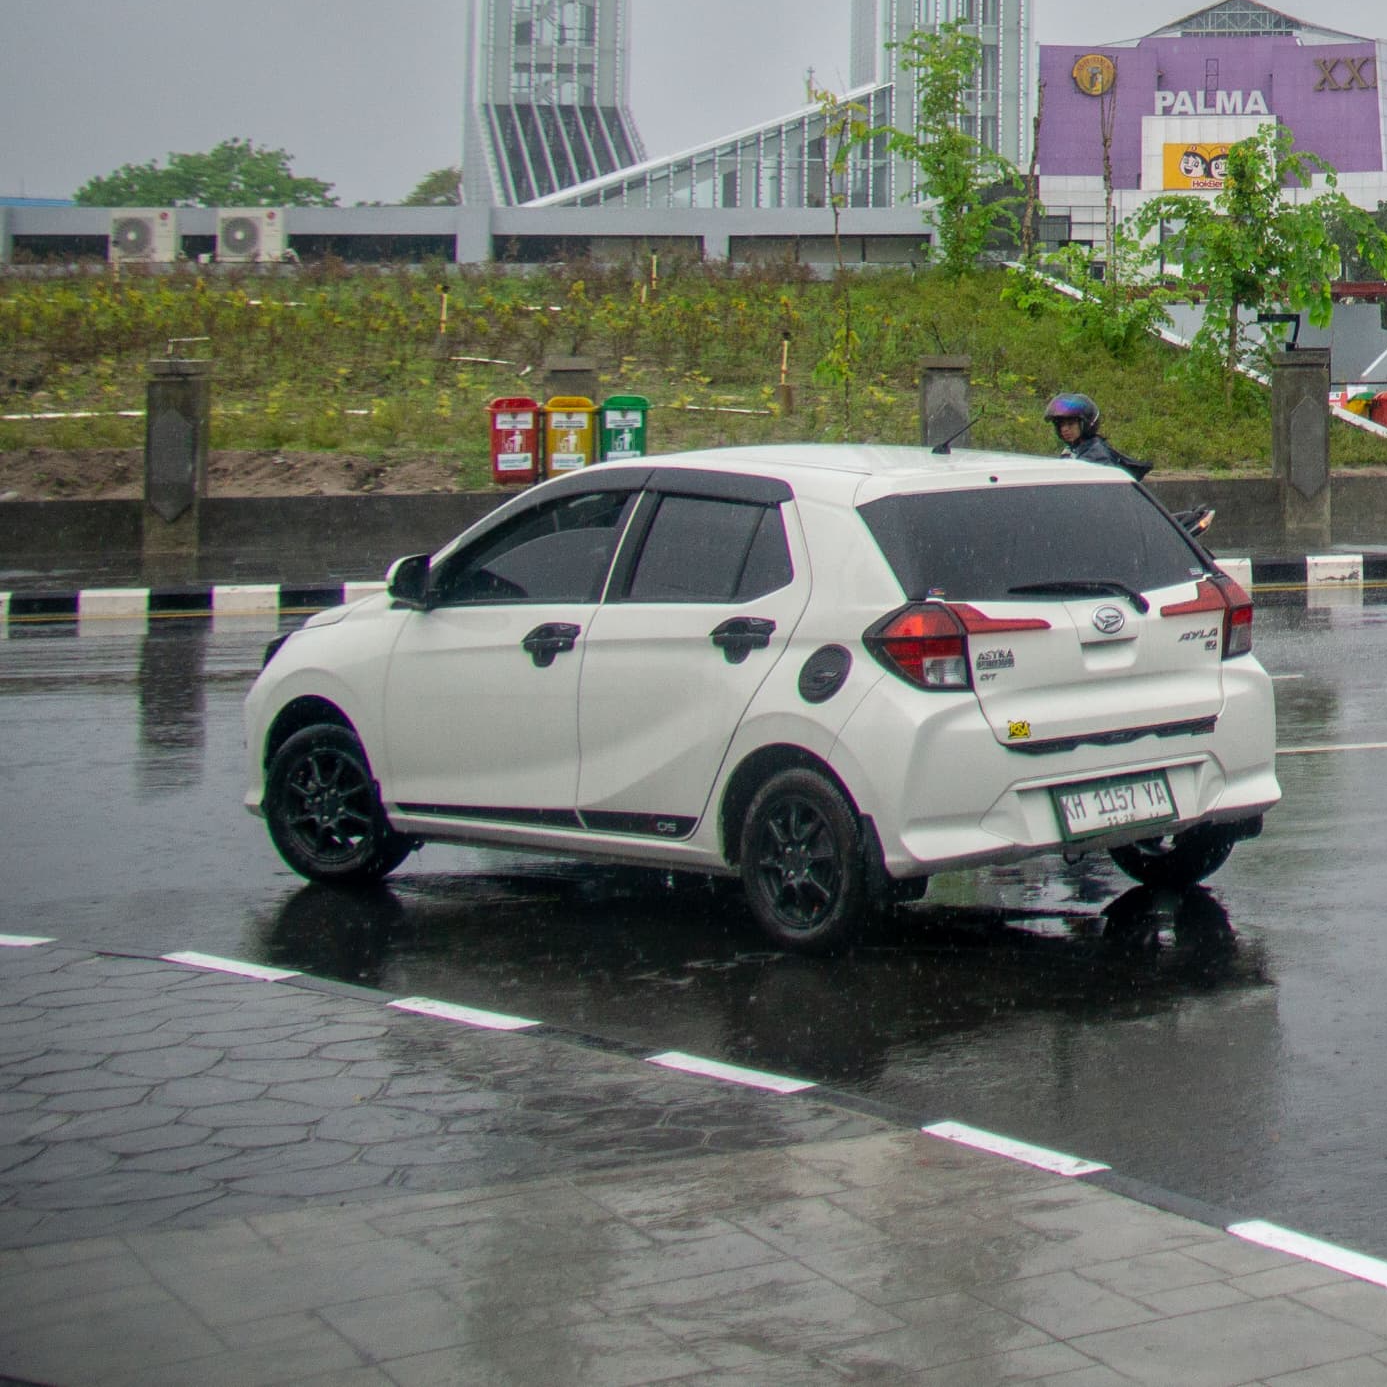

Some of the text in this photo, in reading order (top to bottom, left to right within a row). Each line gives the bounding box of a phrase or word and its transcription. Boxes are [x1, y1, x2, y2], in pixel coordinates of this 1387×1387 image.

[1154, 90, 1269, 115] PALMA
[1178, 627, 1218, 642] AYLA
[977, 648, 1014, 661] ASTRA
[1060, 781, 1167, 820] KH 1157 YA
